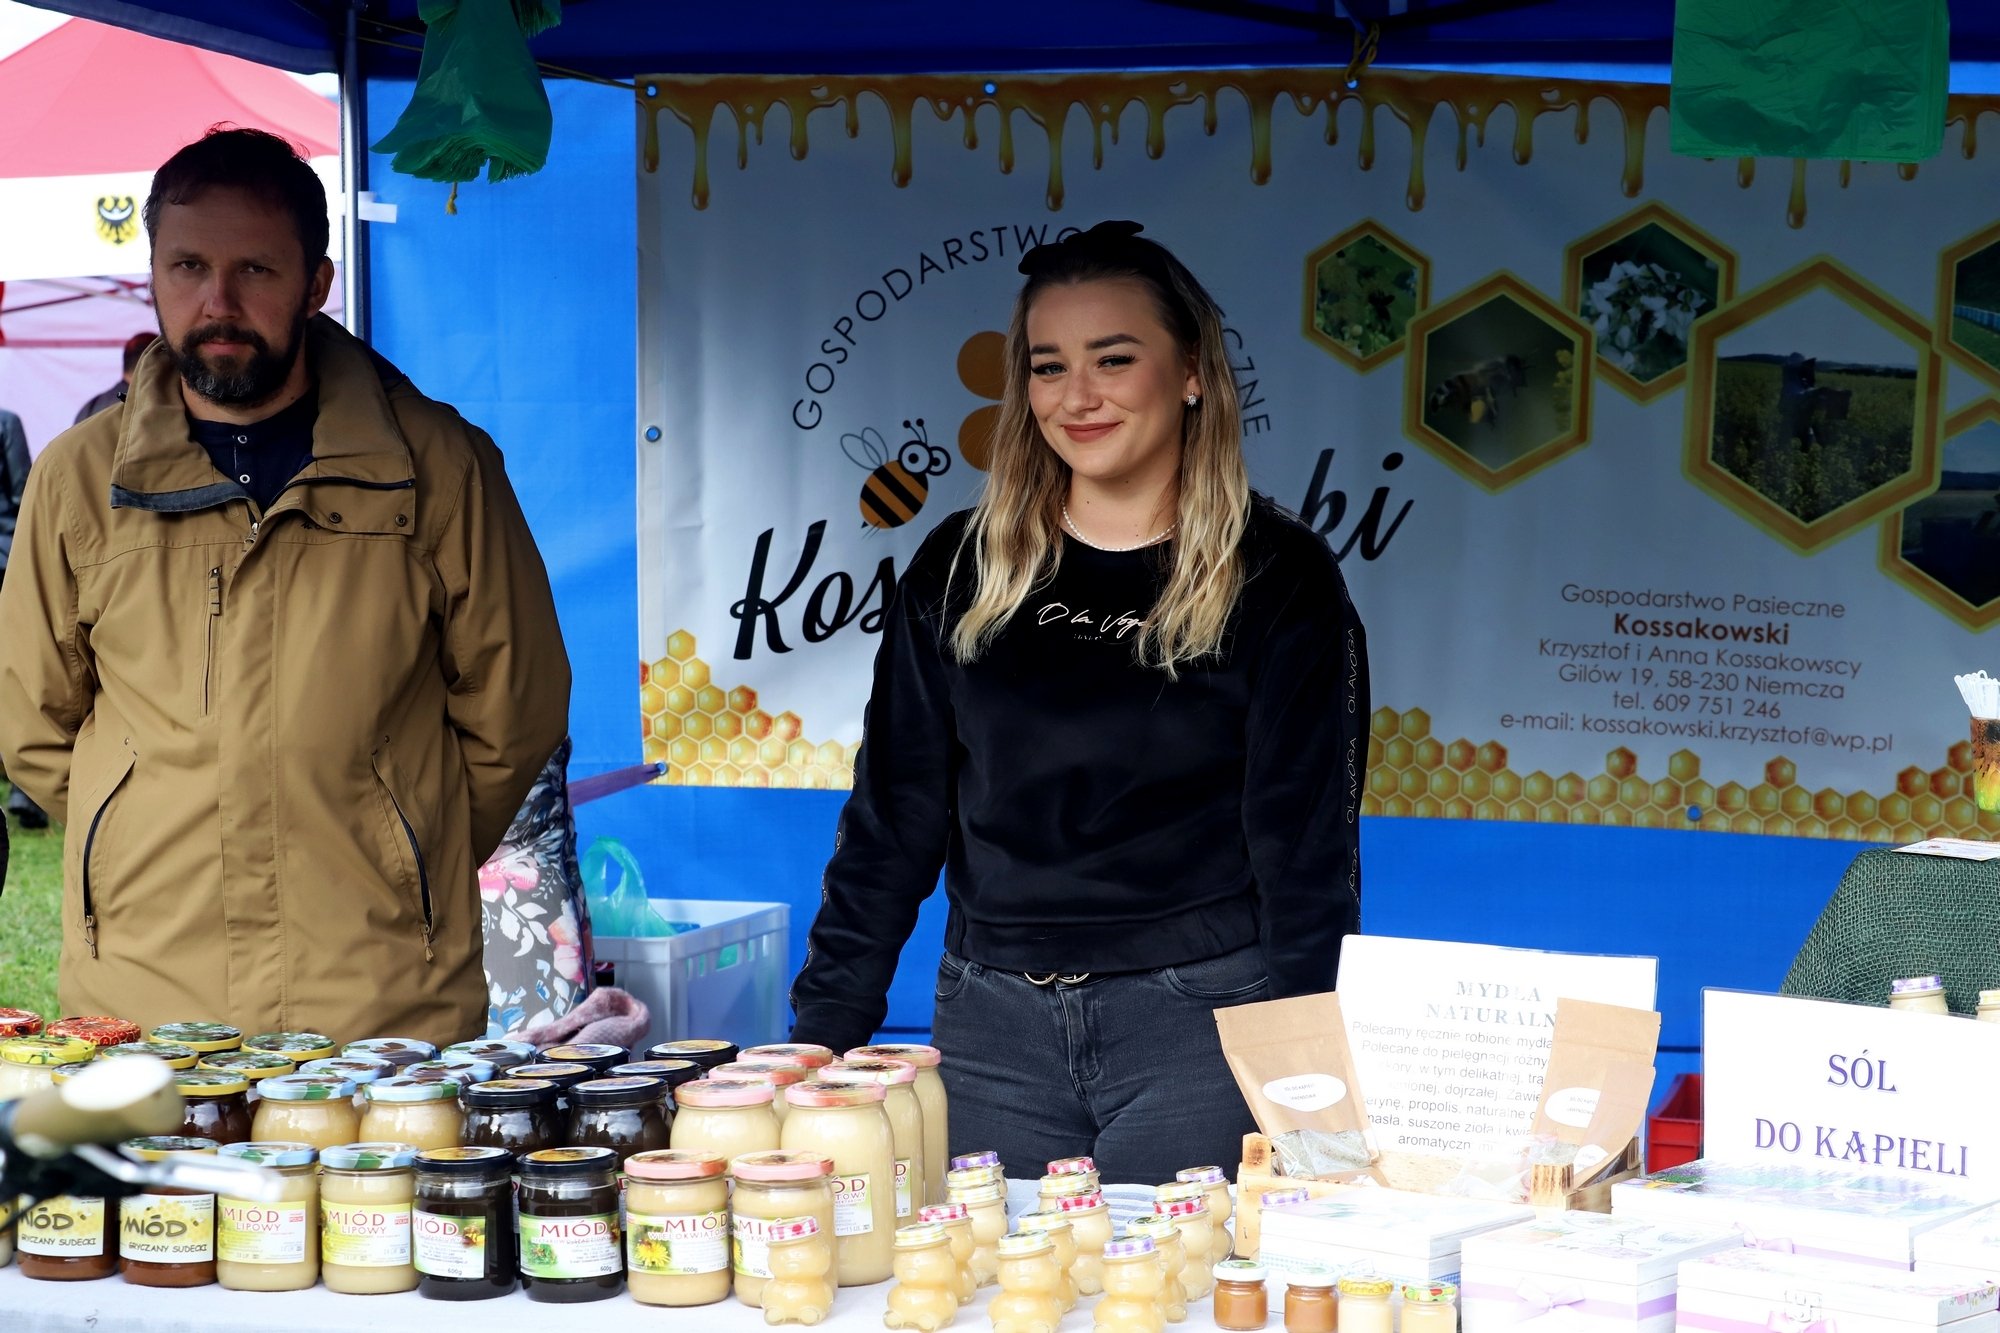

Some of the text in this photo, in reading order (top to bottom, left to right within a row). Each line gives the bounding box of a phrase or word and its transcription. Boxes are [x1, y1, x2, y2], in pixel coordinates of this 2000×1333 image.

[1561, 584, 1846, 618] Gospodarstwo Pasieczne
[1613, 613, 1790, 645] Kossakowski
[1539, 638, 1862, 679] Krzysztof i Anna Kossakowscy
[1348, 628, 1357, 714] OLAVOGA
[1559, 663, 1845, 699] Gilów 19, 58-230 Niemcza
[1613, 690, 1782, 719] tel. 609 751 246
[1500, 711, 1893, 753] e-mail: kossakowski.krzysztof@wp.pl
[1347, 737, 1357, 824] OLAVOGA
[1425, 1003, 1555, 1028] NATURALN
[1352, 1021, 1412, 1039] Polecamy
[1465, 1032, 1512, 1046] robione
[1361, 1040, 1419, 1055] Polecane
[1422, 1046, 1438, 1057] do
[1420, 1065, 1429, 1074] w
[1433, 1065, 1456, 1078] tym
[1827, 1049, 1897, 1092] SÓL
[1507, 1089, 1541, 1102] Zawie
[1466, 1105, 1526, 1119] naturalne
[1408, 1118, 1460, 1132] suszone
[1755, 1118, 1801, 1153] DO
[832, 1177, 866, 1194] ÓD
[224, 1207, 279, 1223] MIÓD
[329, 1210, 385, 1226] MIÓD
[665, 1211, 728, 1232] MIÓD
[124, 1214, 187, 1238] MIÓD
[236, 1222, 281, 1232] LIPOWY
[341, 1225, 387, 1235] LIPOWY
[541, 1219, 607, 1238] MIÓD
[59, 1238, 96, 1246] SUDECKI
[128, 1241, 207, 1253] GRYCZANY SUDECKI
